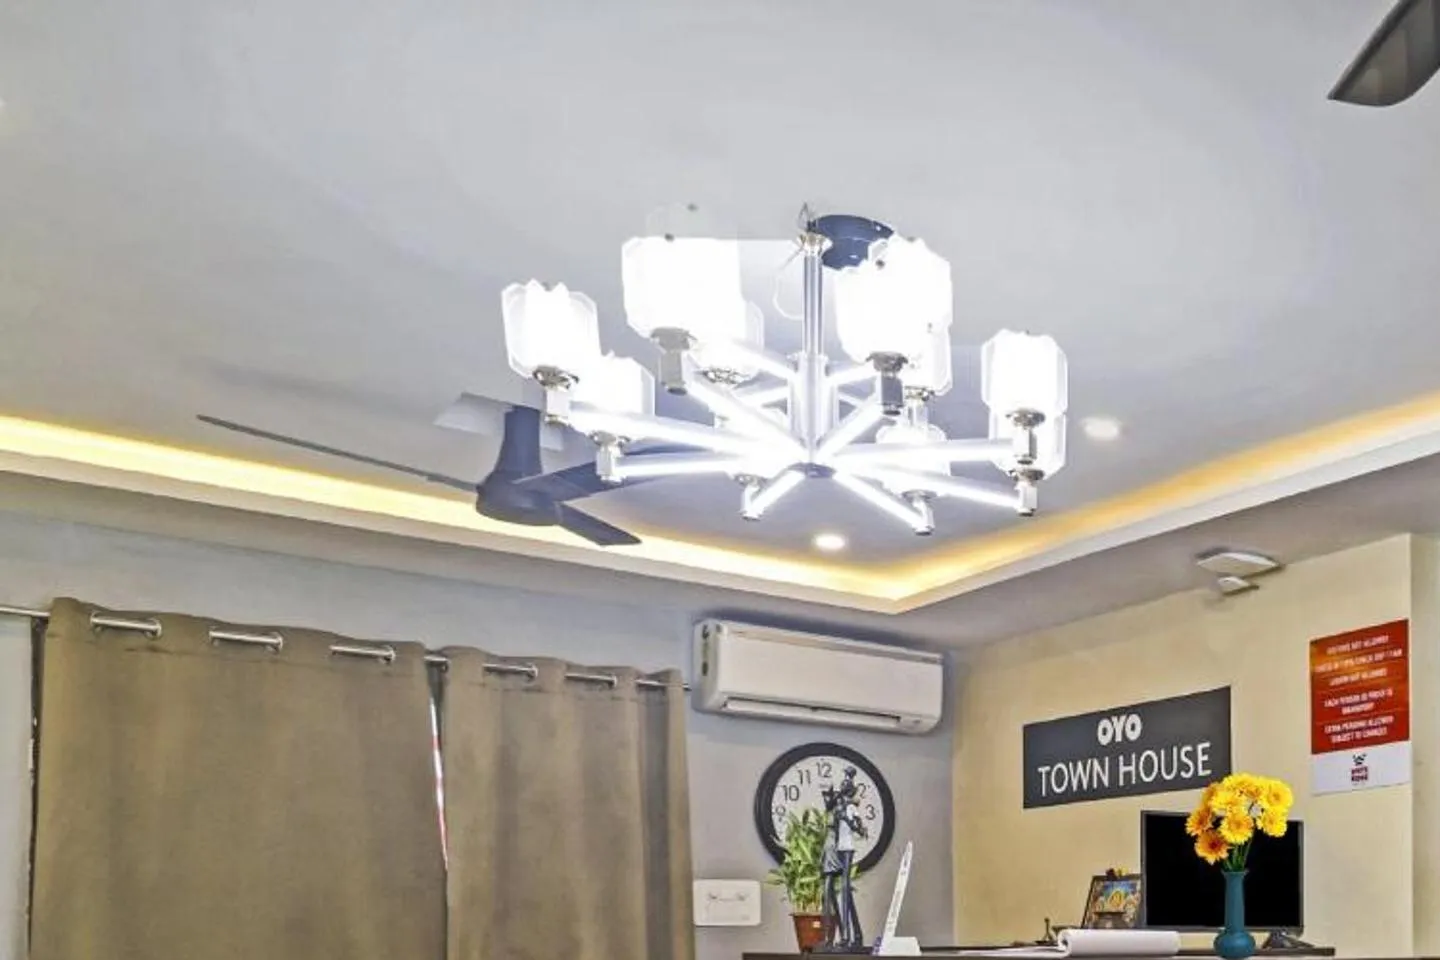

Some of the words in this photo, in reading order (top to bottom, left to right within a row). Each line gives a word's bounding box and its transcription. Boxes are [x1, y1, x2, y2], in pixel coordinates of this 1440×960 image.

[1097, 713, 1143, 746] OYO
[798, 769, 812, 786] 11
[816, 761, 832, 779] 12
[1037, 755, 1110, 798] TOWN
[1118, 741, 1213, 787] HOUSE
[781, 784, 800, 803] 10
[775, 804, 786, 822] 9
[865, 803, 876, 821] 3
